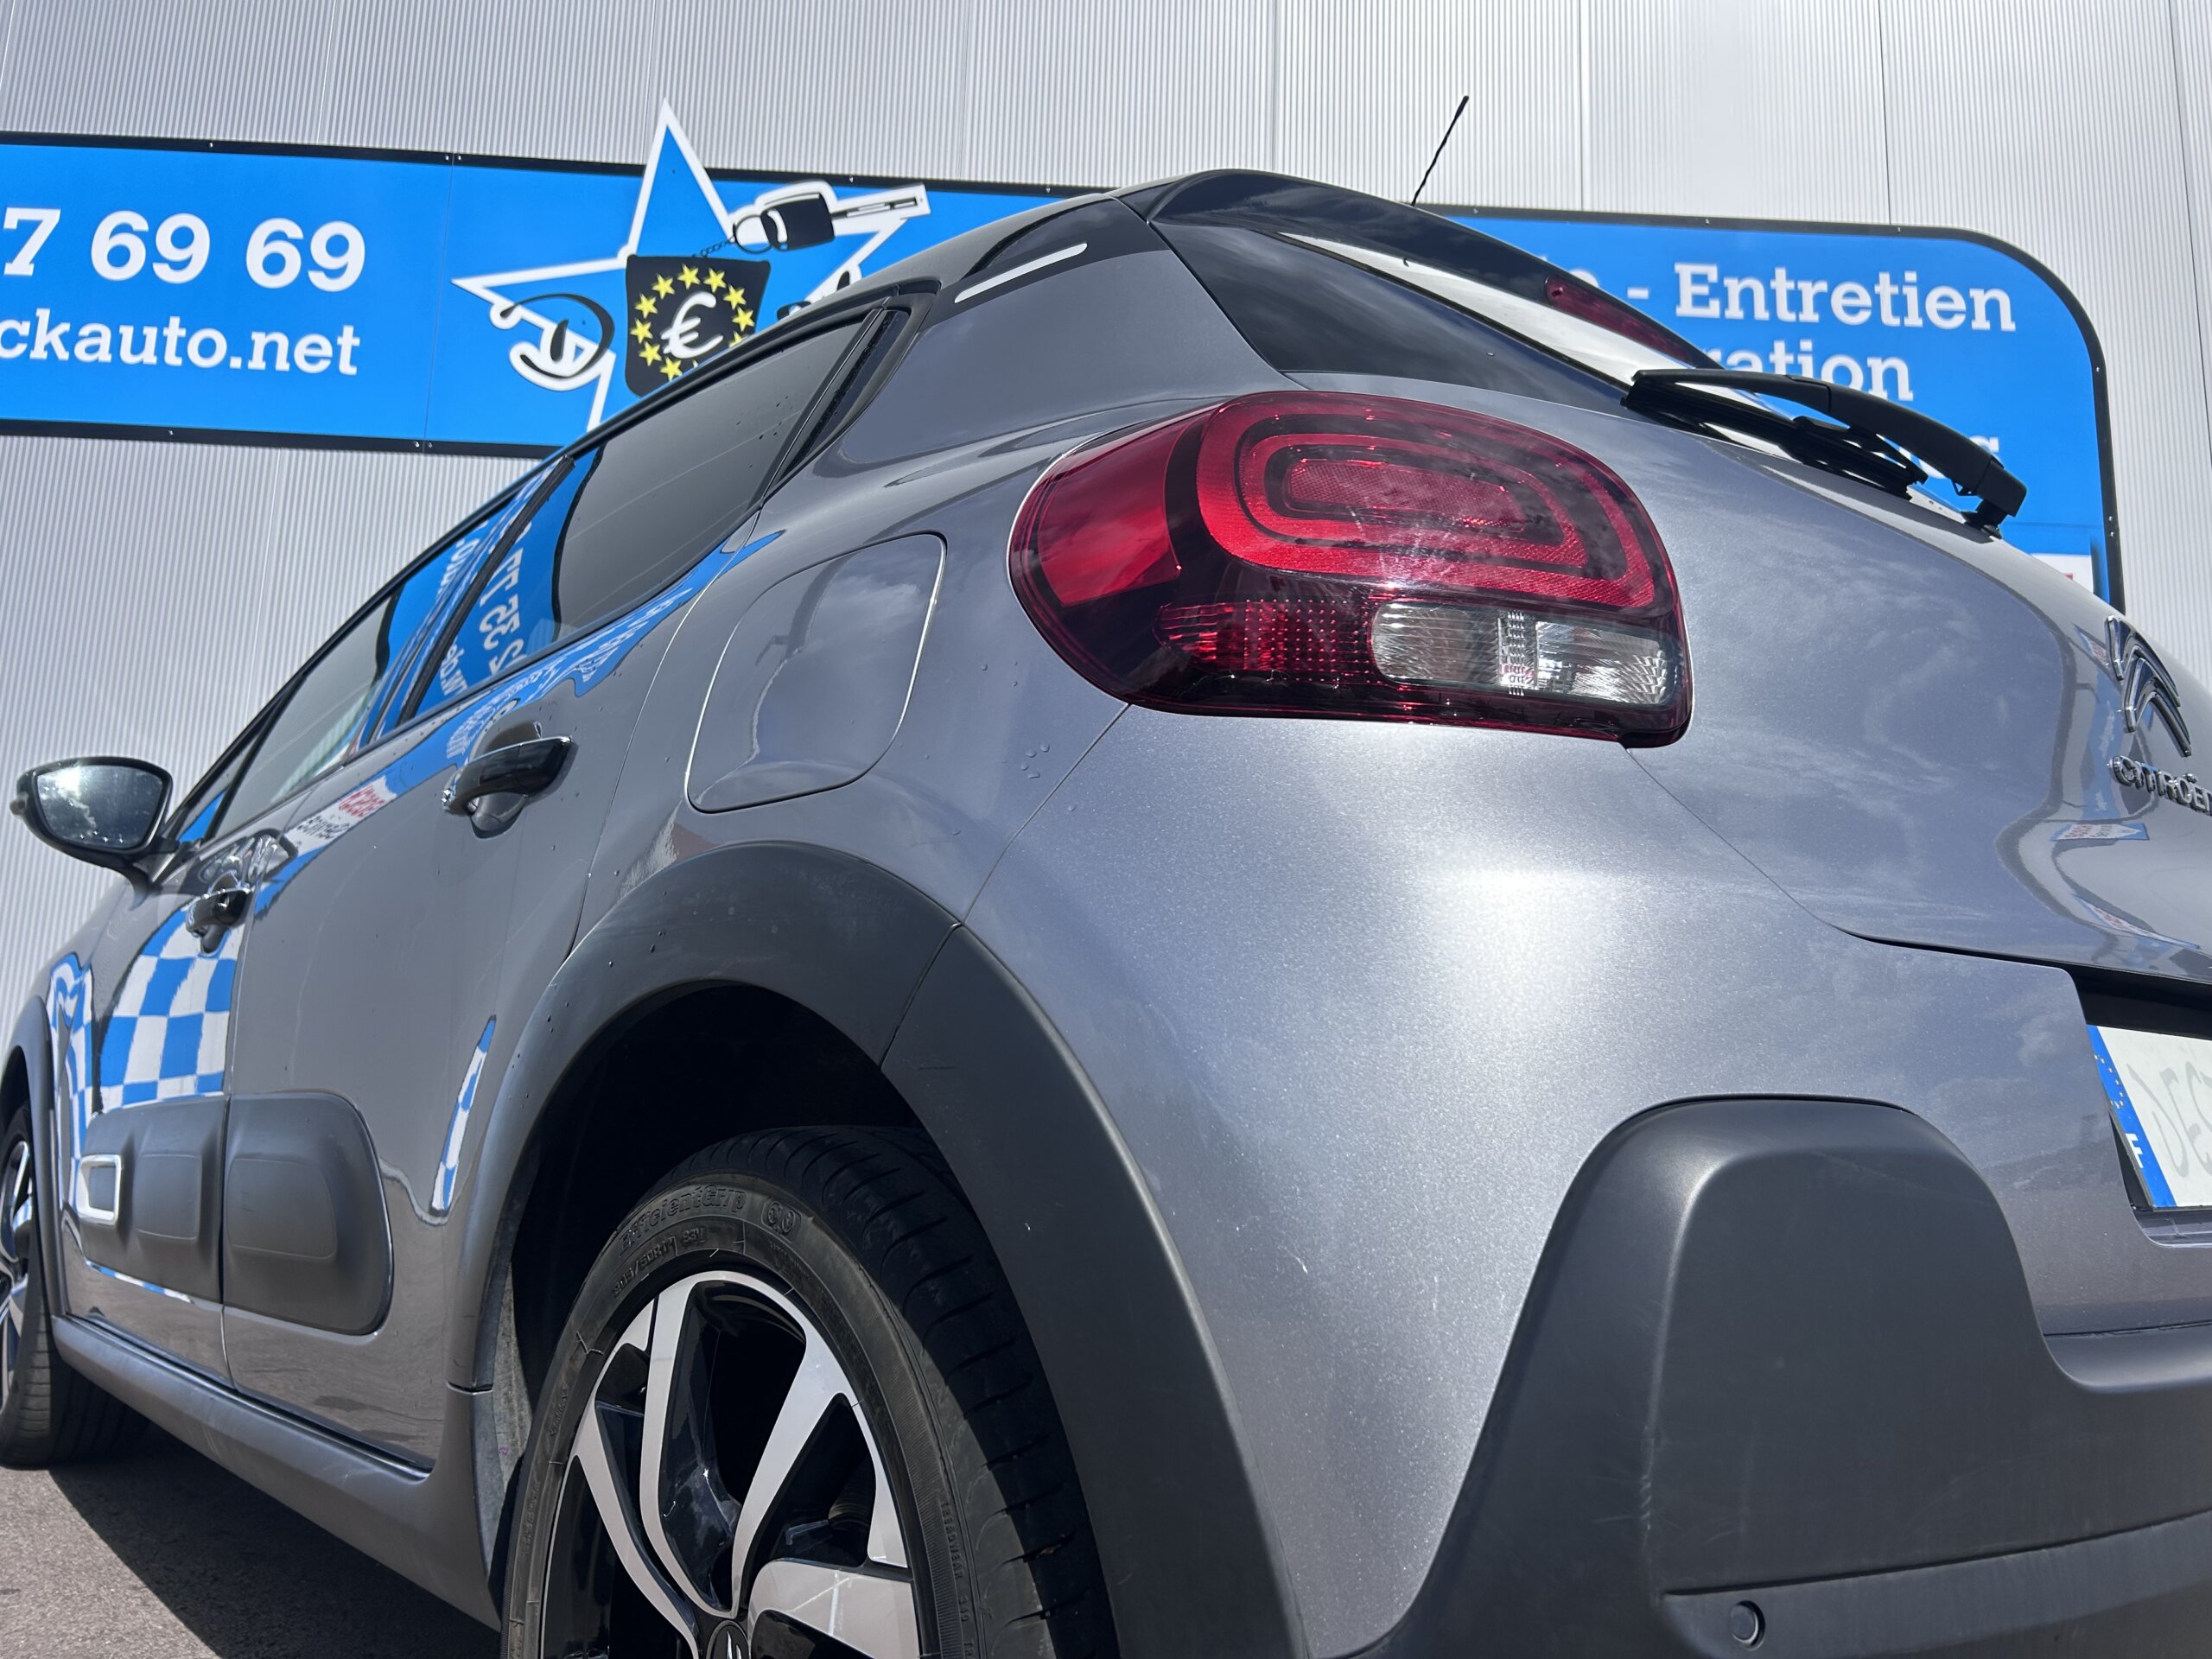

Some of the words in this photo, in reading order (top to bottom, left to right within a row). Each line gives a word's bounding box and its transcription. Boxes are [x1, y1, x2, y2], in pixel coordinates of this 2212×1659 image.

[91, 211, 210, 284] 69
[245, 218, 365, 292] 69
[1675, 262, 2016, 332] Entretien
[0, 308, 360, 375] ckauto.net
